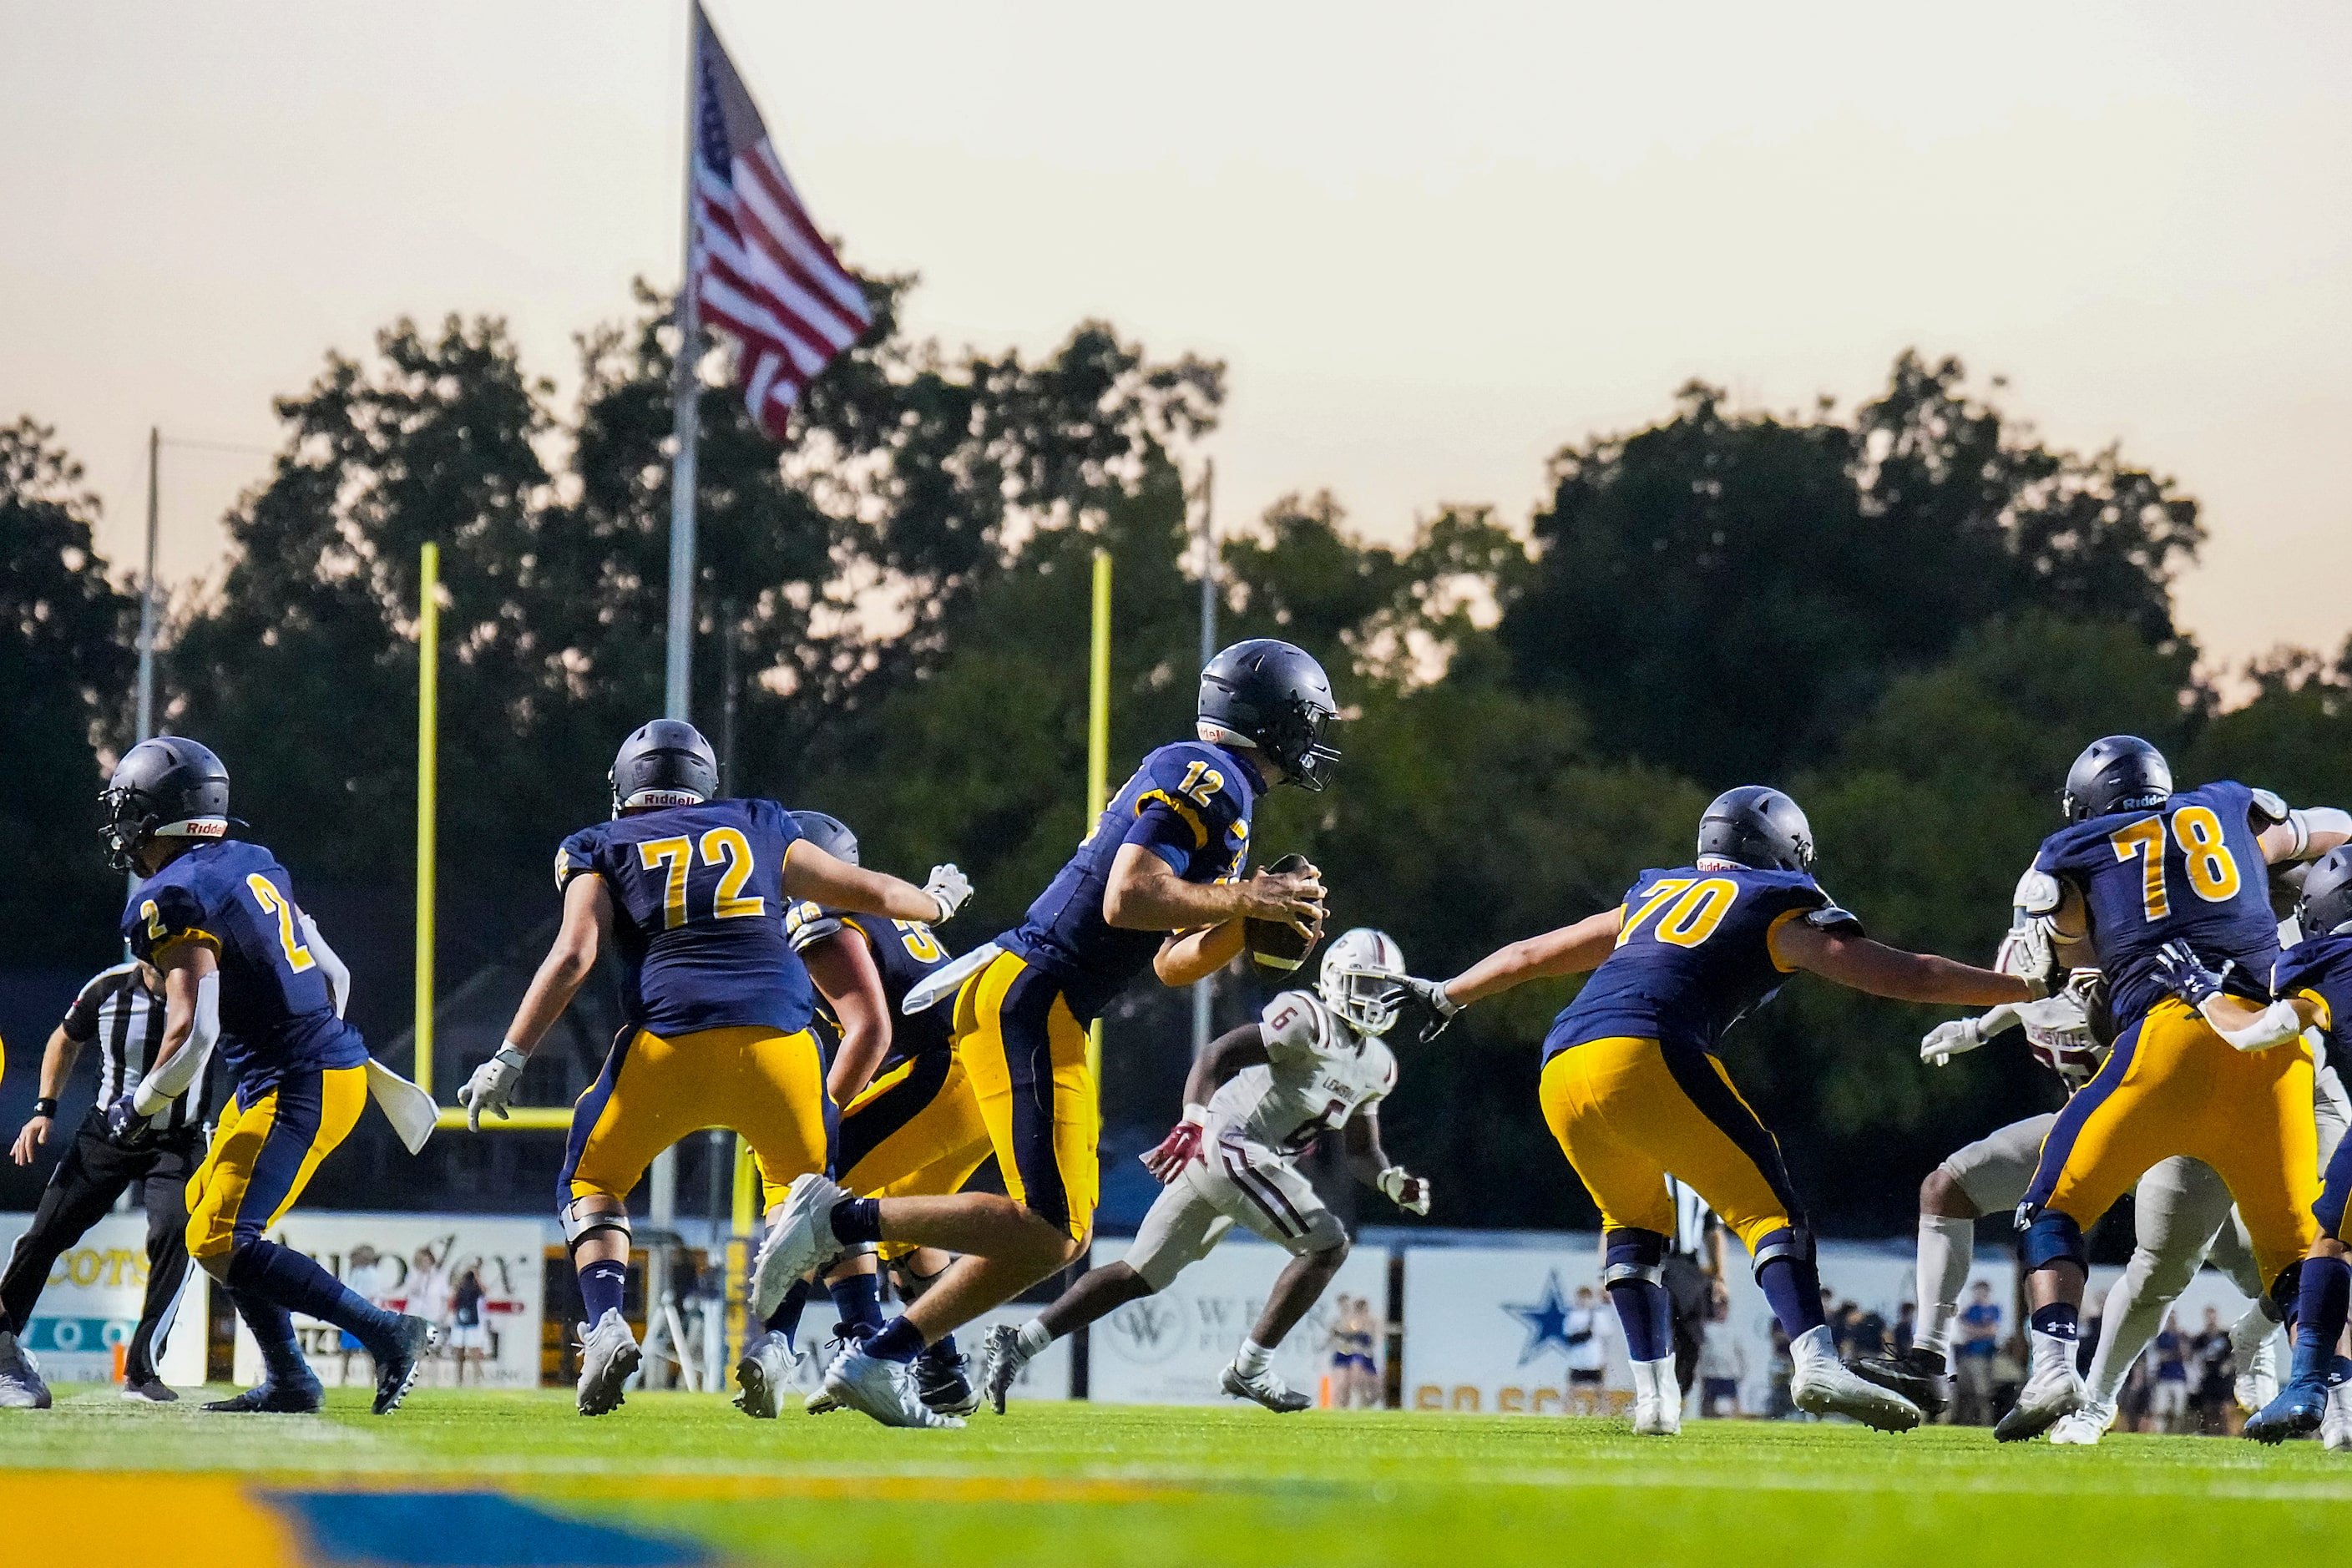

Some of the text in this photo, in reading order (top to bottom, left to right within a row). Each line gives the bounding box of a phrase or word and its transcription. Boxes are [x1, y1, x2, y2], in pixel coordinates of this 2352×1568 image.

[645, 793, 695, 807] Riddell
[1178, 760, 1225, 807] 12
[636, 826, 766, 930] 72
[2108, 806, 2241, 922] 78
[139, 898, 168, 940] 2
[246, 873, 316, 974] 2
[1614, 878, 1739, 949] 70
[1271, 1006, 1298, 1031] 6
